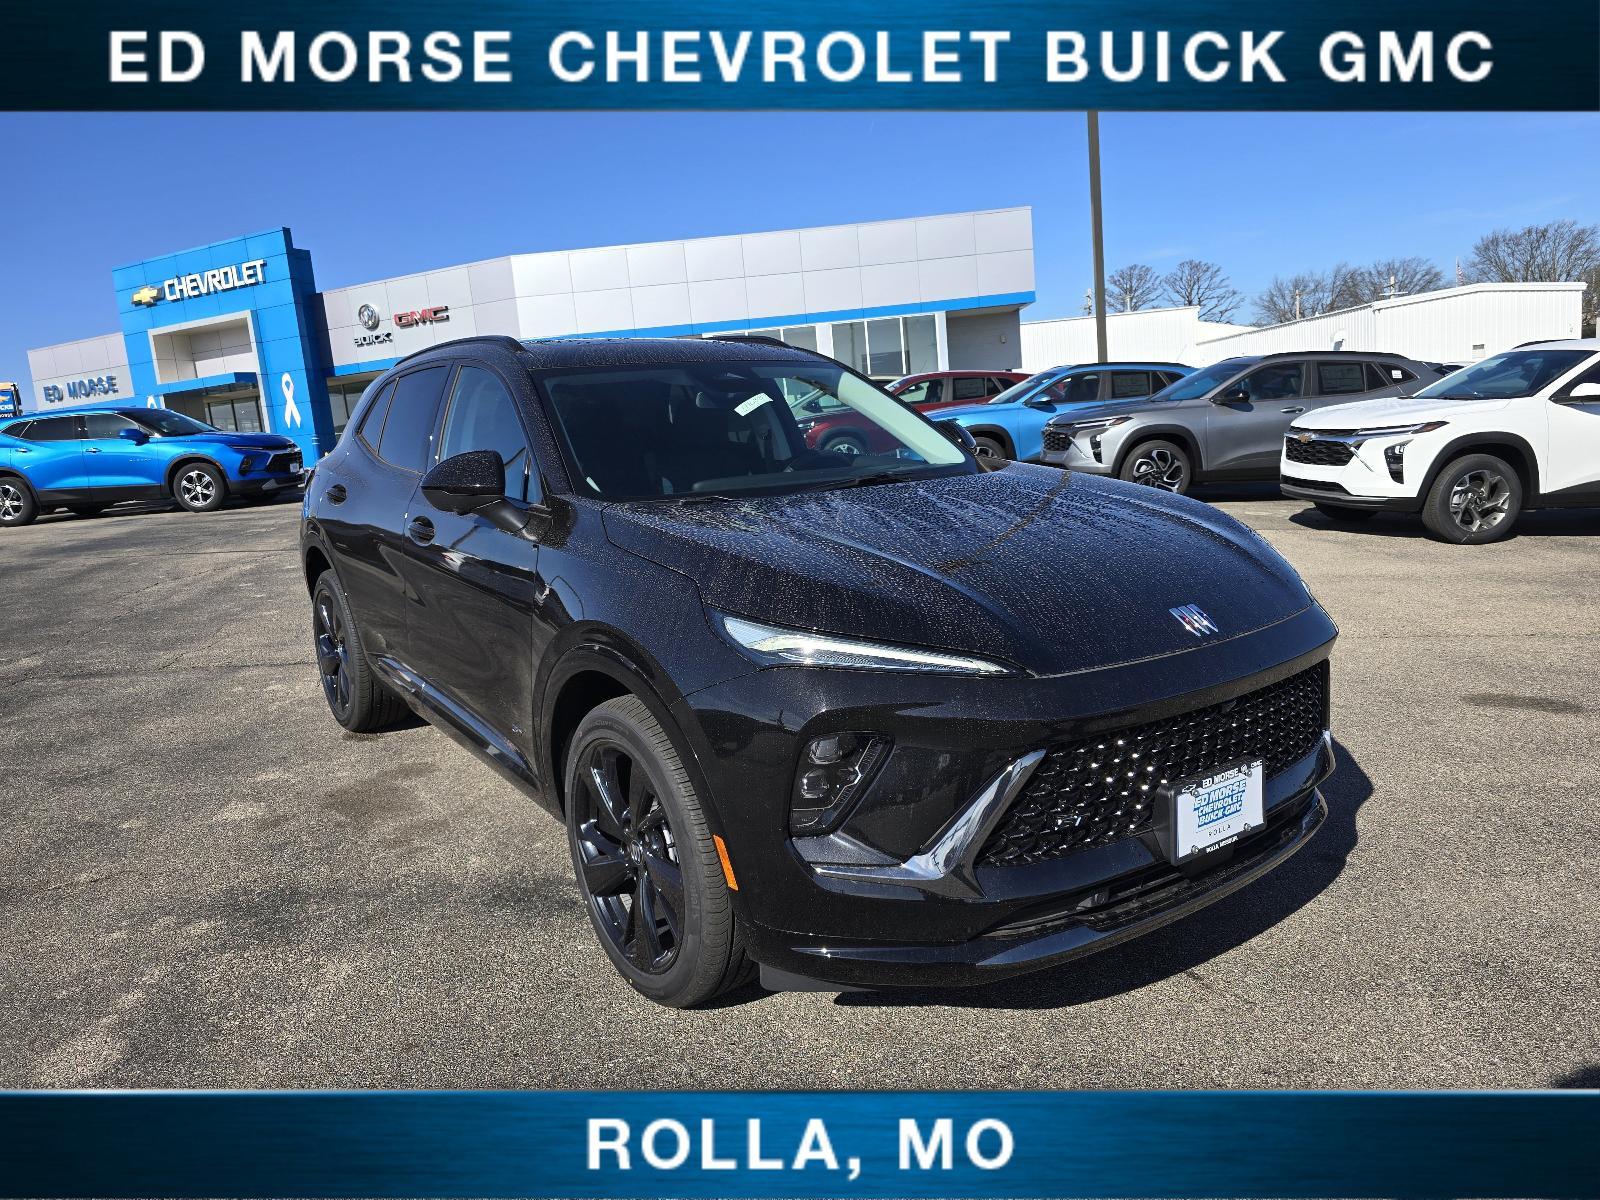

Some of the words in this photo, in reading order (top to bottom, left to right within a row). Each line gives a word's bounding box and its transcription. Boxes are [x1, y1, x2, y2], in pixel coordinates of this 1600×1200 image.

[163, 259, 266, 302] CHEVROLET
[394, 306, 449, 328] GMC
[354, 332, 393, 347] BUICK
[43, 384, 63, 403] ED
[66, 375, 118, 399] MORSE
[1202, 777, 1213, 789] ED
[1213, 768, 1239, 784] MORSE
[1194, 792, 1210, 810] ED
[1209, 780, 1246, 804] MORSE
[1198, 794, 1243, 817] CHEVROLET
[1209, 824, 1231, 837] ROLLA
